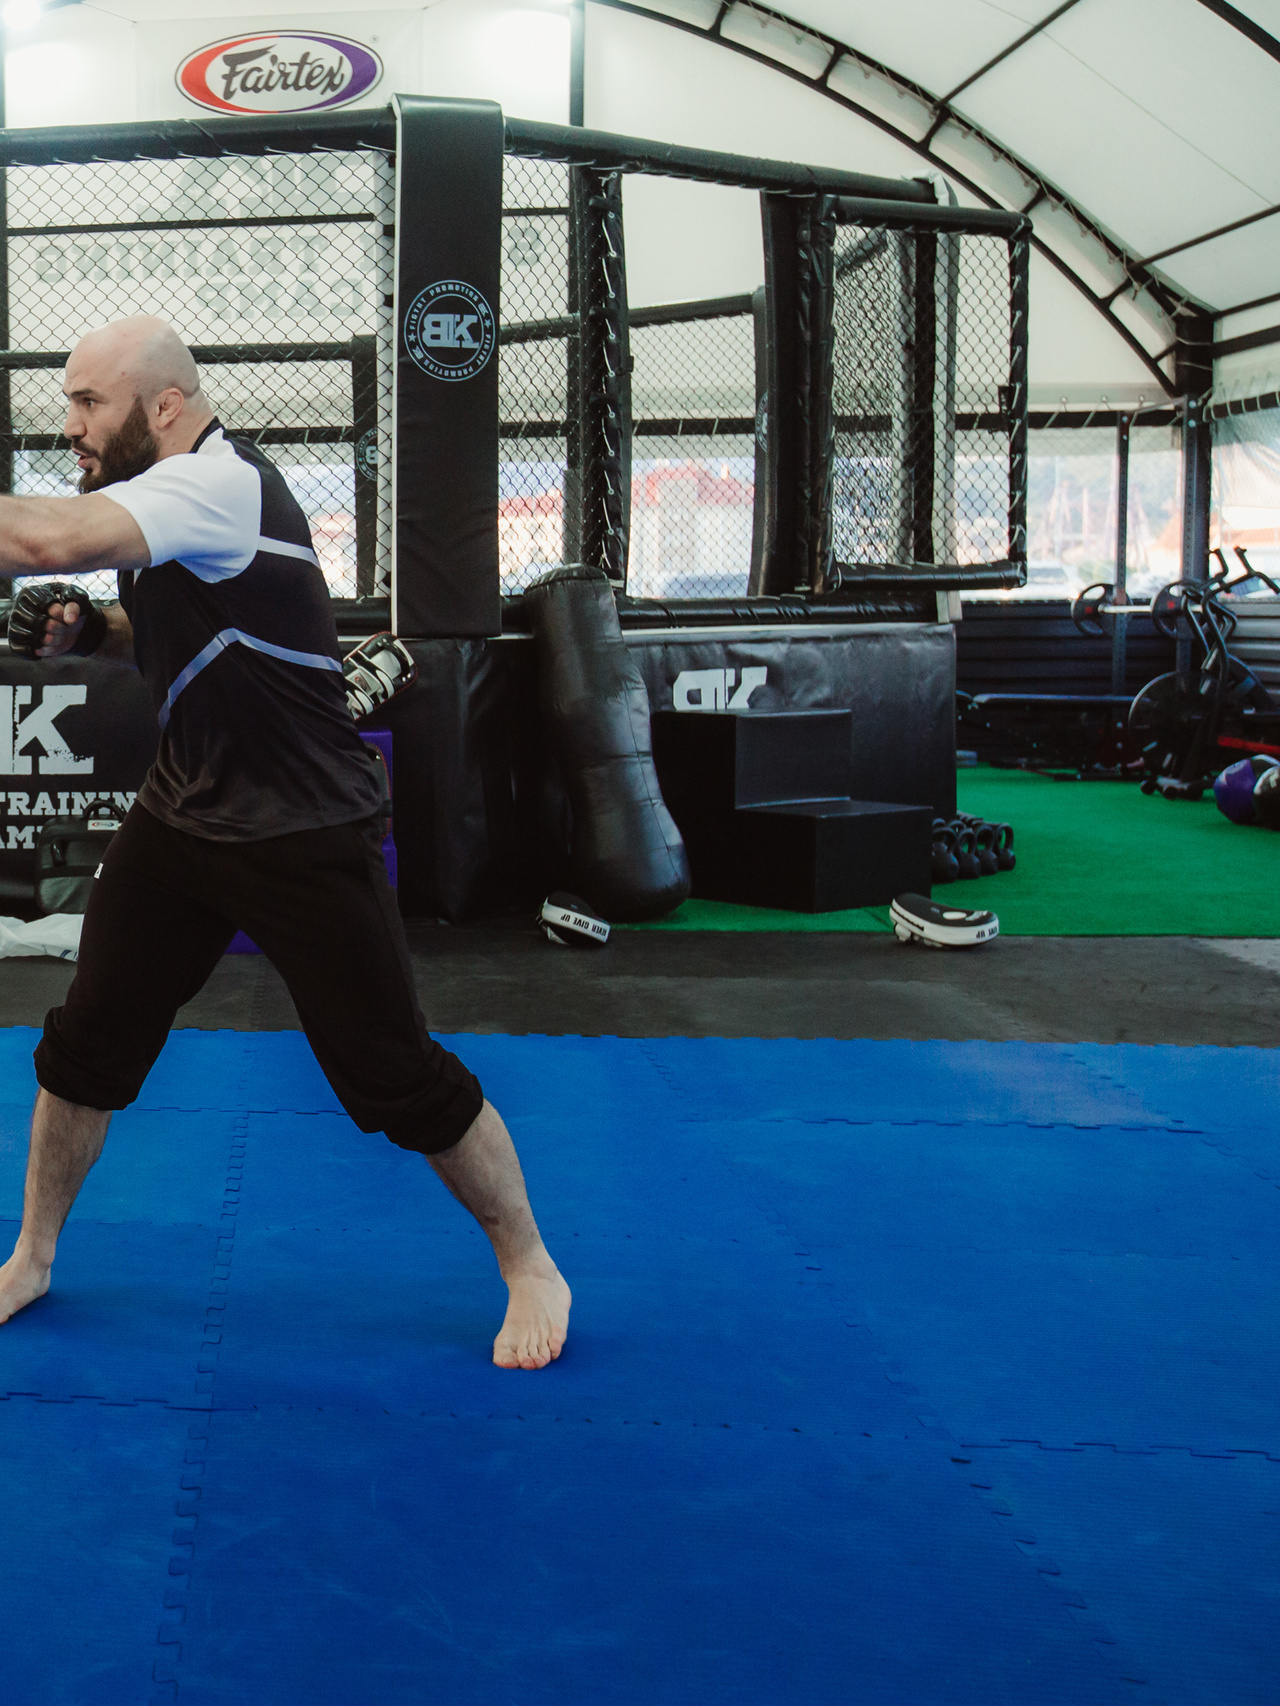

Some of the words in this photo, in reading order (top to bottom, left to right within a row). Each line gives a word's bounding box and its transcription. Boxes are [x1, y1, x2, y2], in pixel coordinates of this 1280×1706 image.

[221, 44, 346, 100] Fairtex
[422, 313, 480, 349] BK
[560, 913, 571, 922] UP
[573, 917, 589, 929] GIVE
